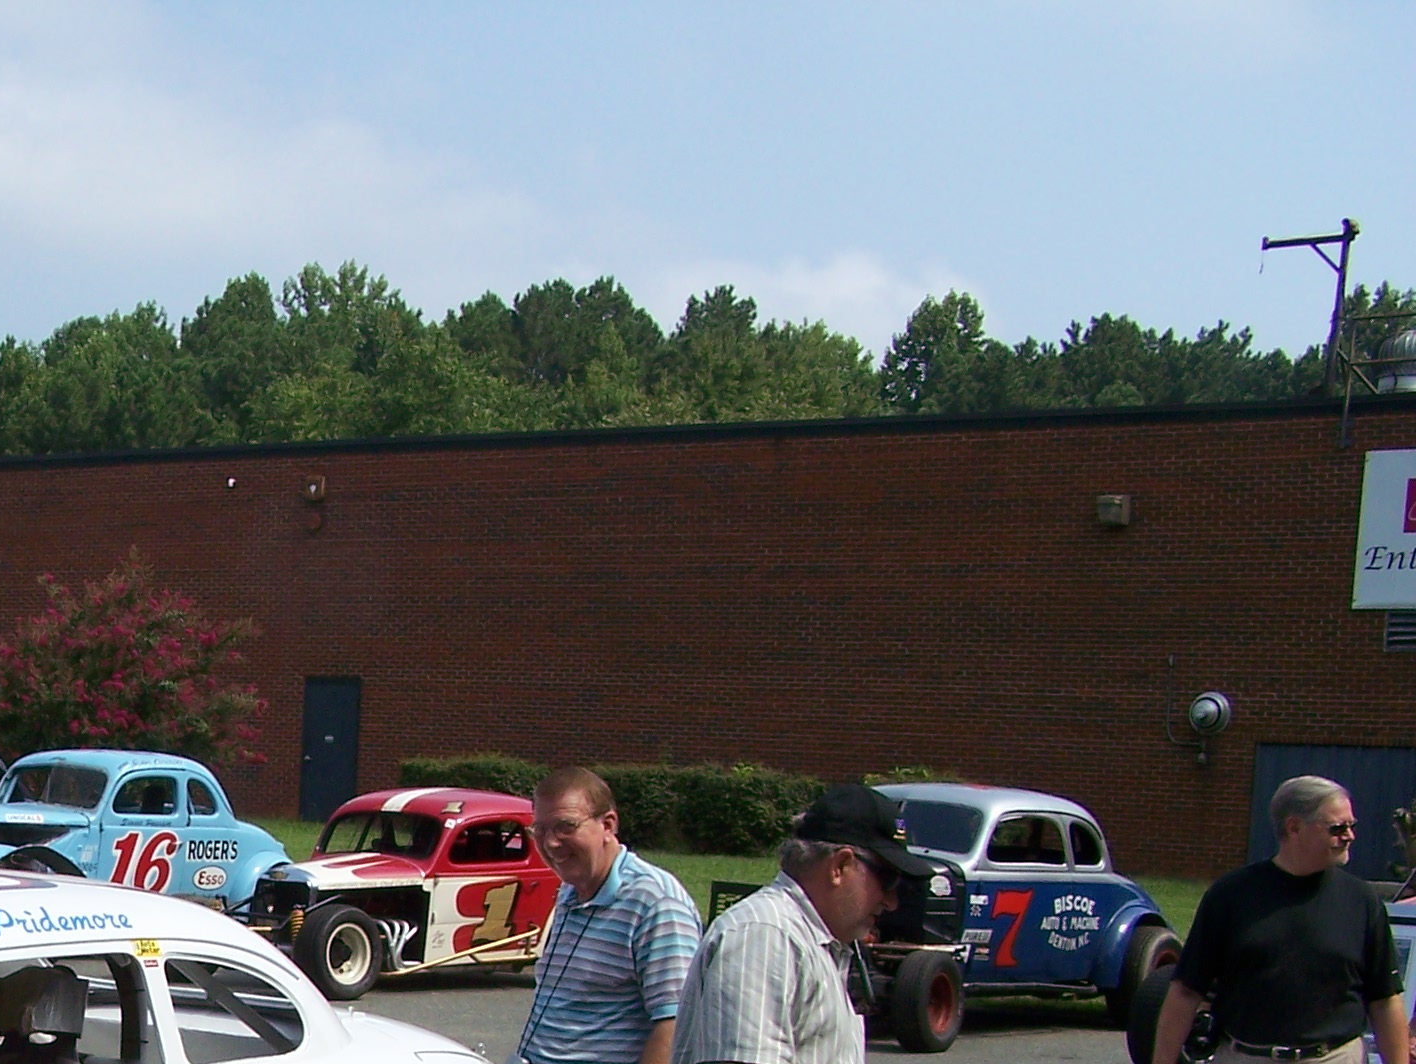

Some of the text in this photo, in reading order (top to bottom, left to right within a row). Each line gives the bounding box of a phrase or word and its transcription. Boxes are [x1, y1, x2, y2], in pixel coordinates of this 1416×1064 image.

[187, 839, 238, 861] ROGER'S
[110, 829, 182, 894] 16
[197, 870, 224, 886] Esso
[471, 881, 519, 949] 1
[1053, 895, 1096, 916] BISCOE
[991, 888, 1034, 968] 7
[1040, 916, 1060, 930] AUTO
[1070, 916, 1100, 930] MACHINE
